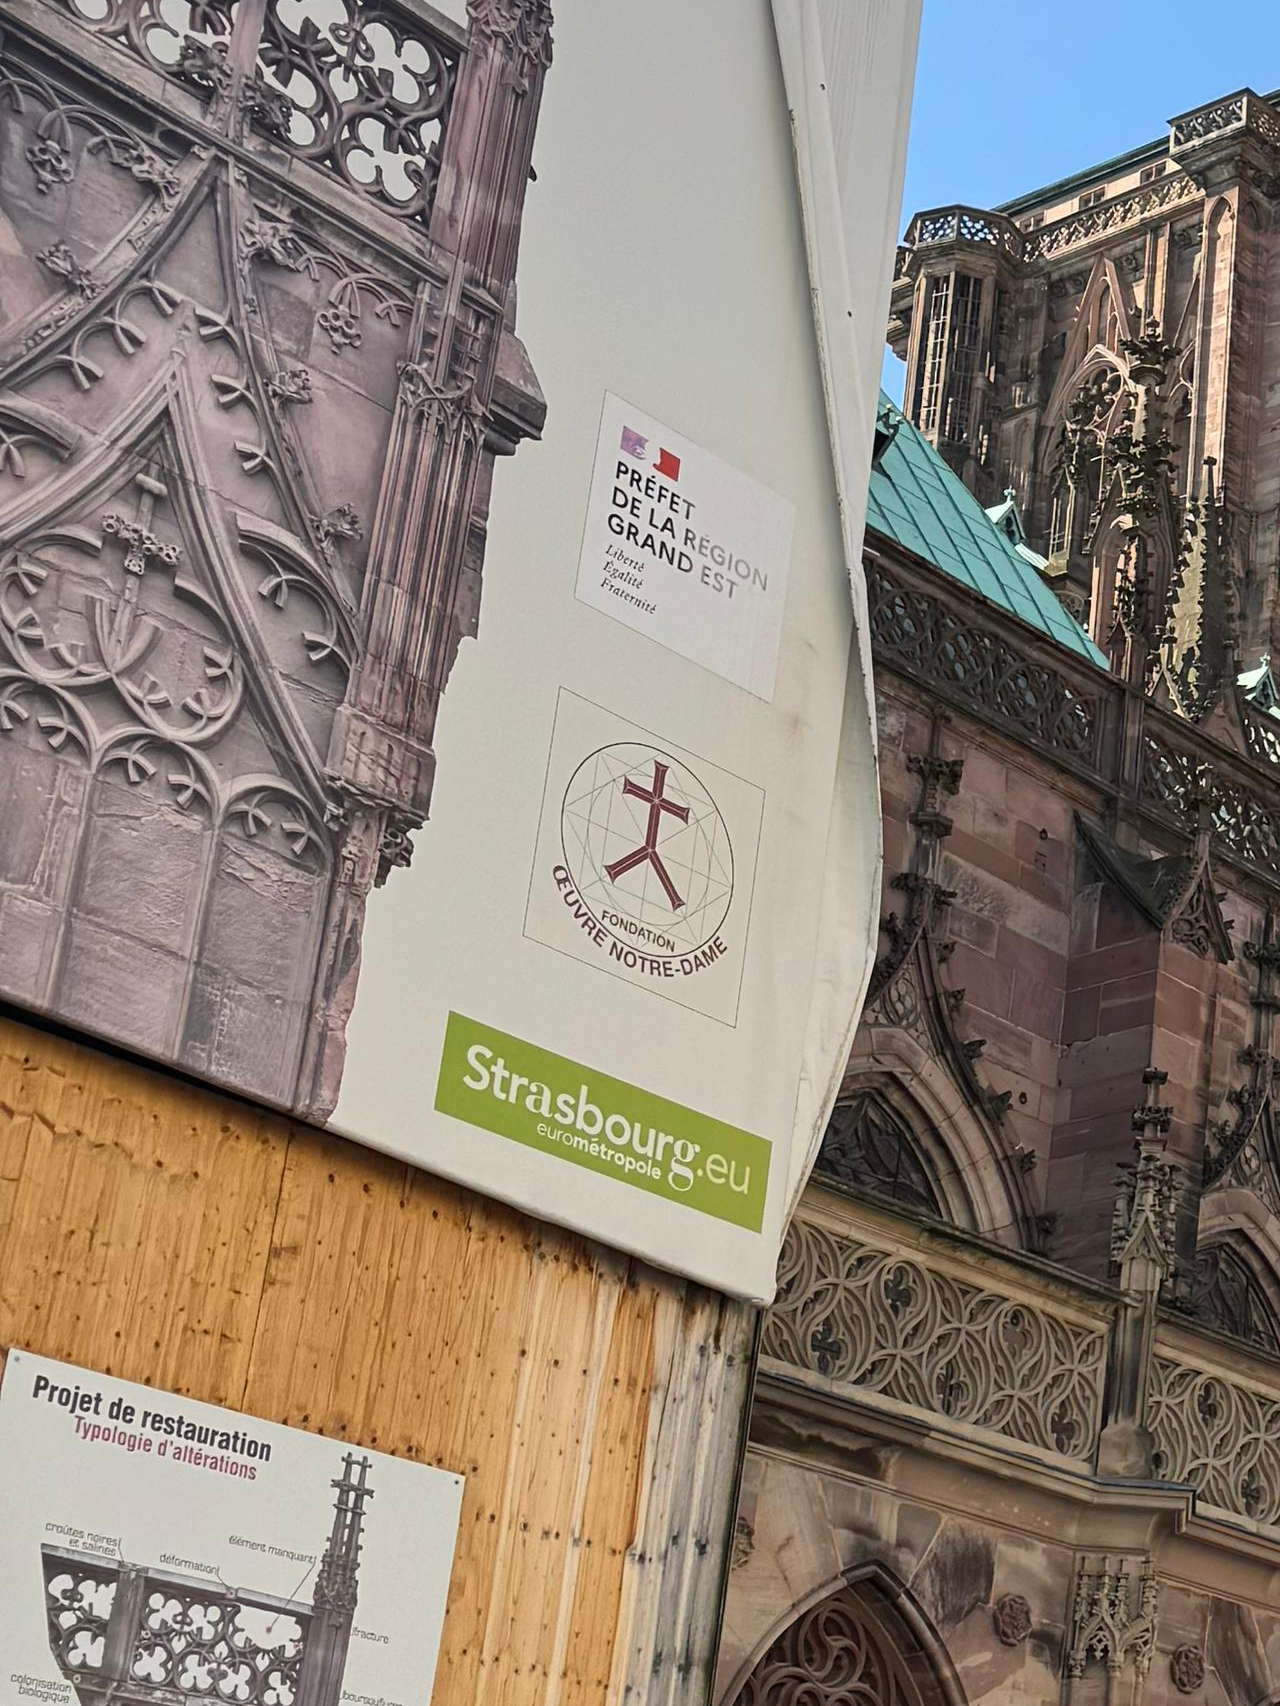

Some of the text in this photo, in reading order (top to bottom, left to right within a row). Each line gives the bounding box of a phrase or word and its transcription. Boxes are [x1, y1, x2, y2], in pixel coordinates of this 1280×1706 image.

[616, 460, 696, 520] PRÉFET
[605, 544, 645, 573] Liberté
[608, 513, 739, 599] GRAND EST
[612, 486, 768, 592] DE LA RÉGION
[600, 577, 657, 615] Fraternité
[602, 560, 643, 590] Égalité
[552, 865, 728, 978] ŒUVRE NOTRE-DAME
[601, 910, 676, 953] FONDATION
[462, 1044, 751, 1195] Strasbourg.eu
[537, 1122, 661, 1180] eurométropole
[32, 1375, 272, 1461] Projet de restauration
[74, 1415, 257, 1481] Typologie d'altérations
[87, 1532, 118, 1548] noires
